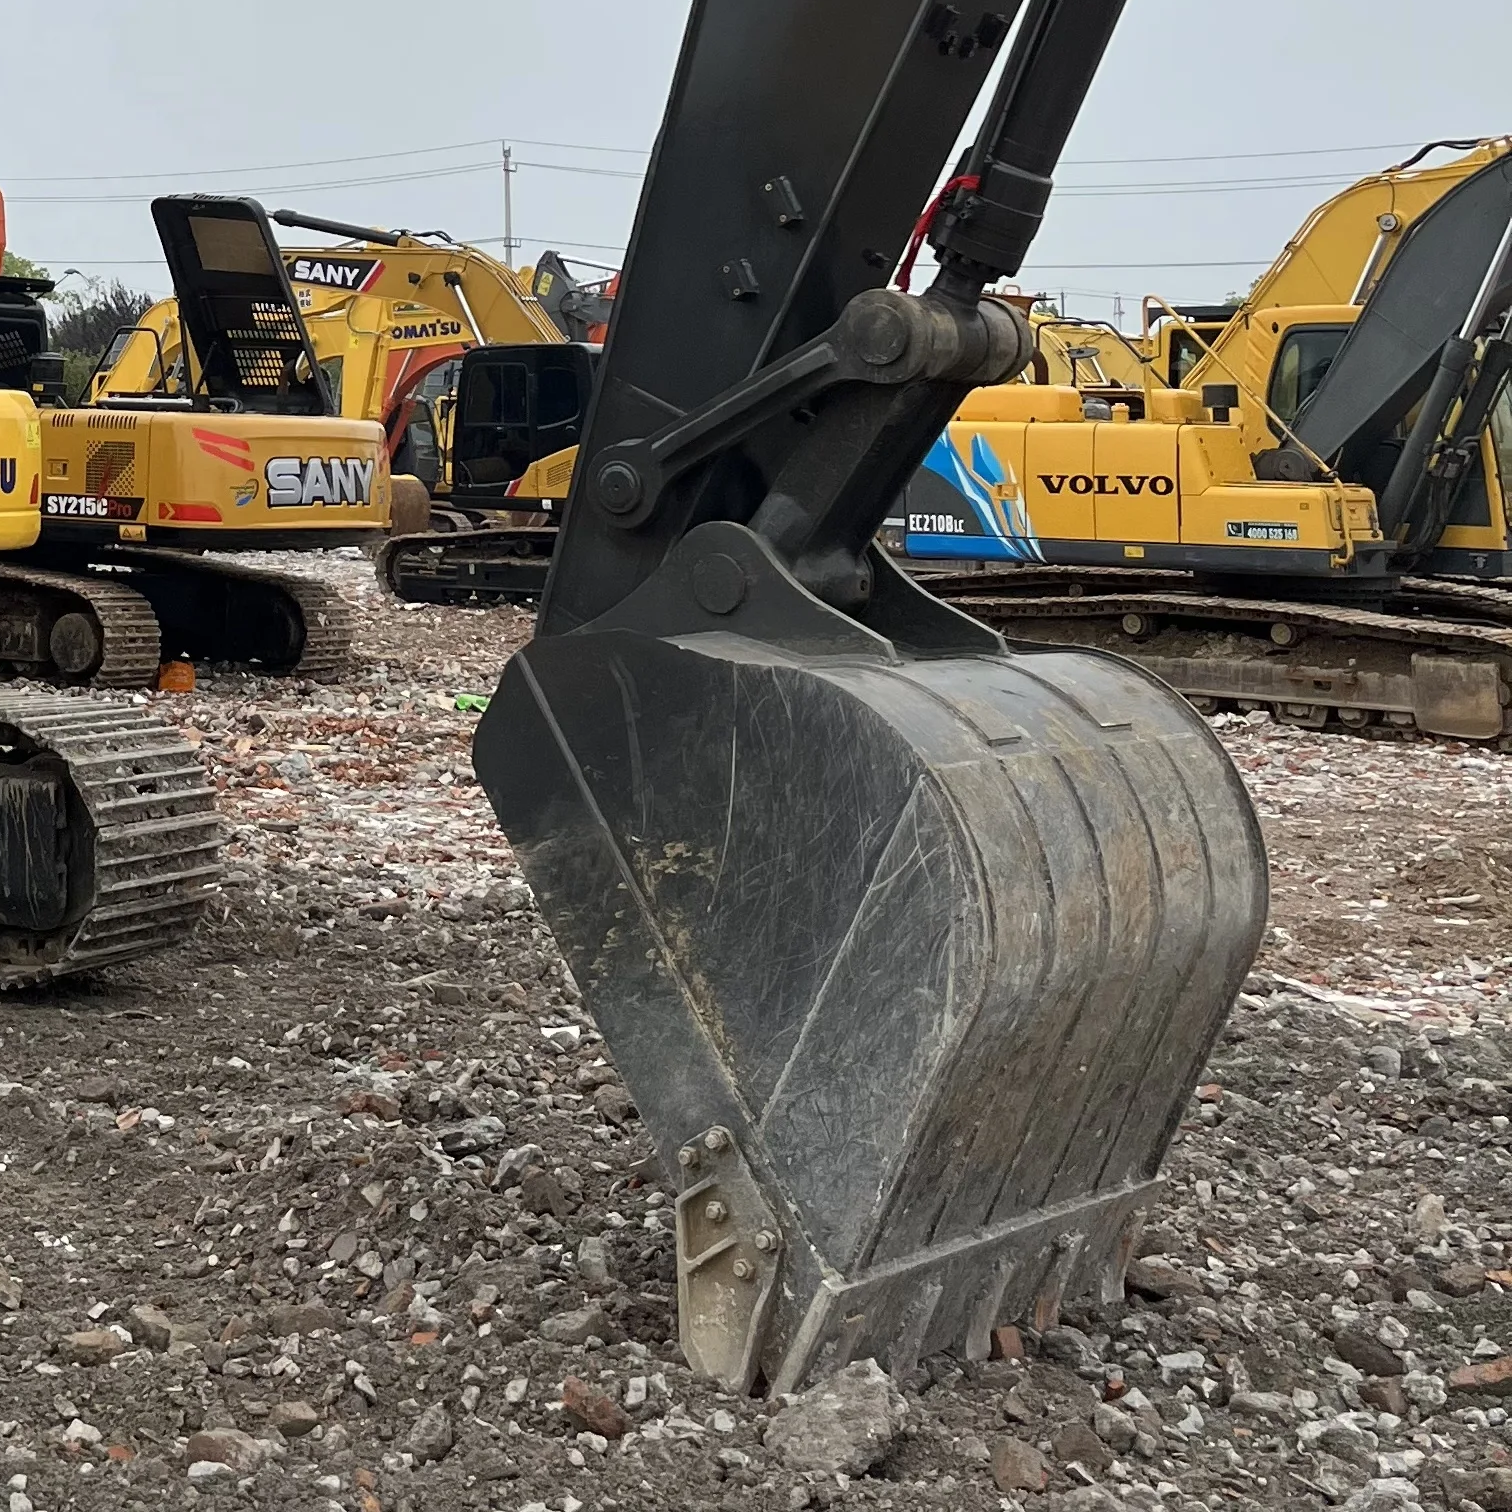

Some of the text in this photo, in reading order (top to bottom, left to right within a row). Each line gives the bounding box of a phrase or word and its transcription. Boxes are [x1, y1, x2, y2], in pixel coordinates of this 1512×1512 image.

[294, 259, 360, 287] SANY
[391, 318, 462, 340] OMATSU
[265, 456, 375, 507] SANY
[1037, 474, 1175, 496] VOLVO
